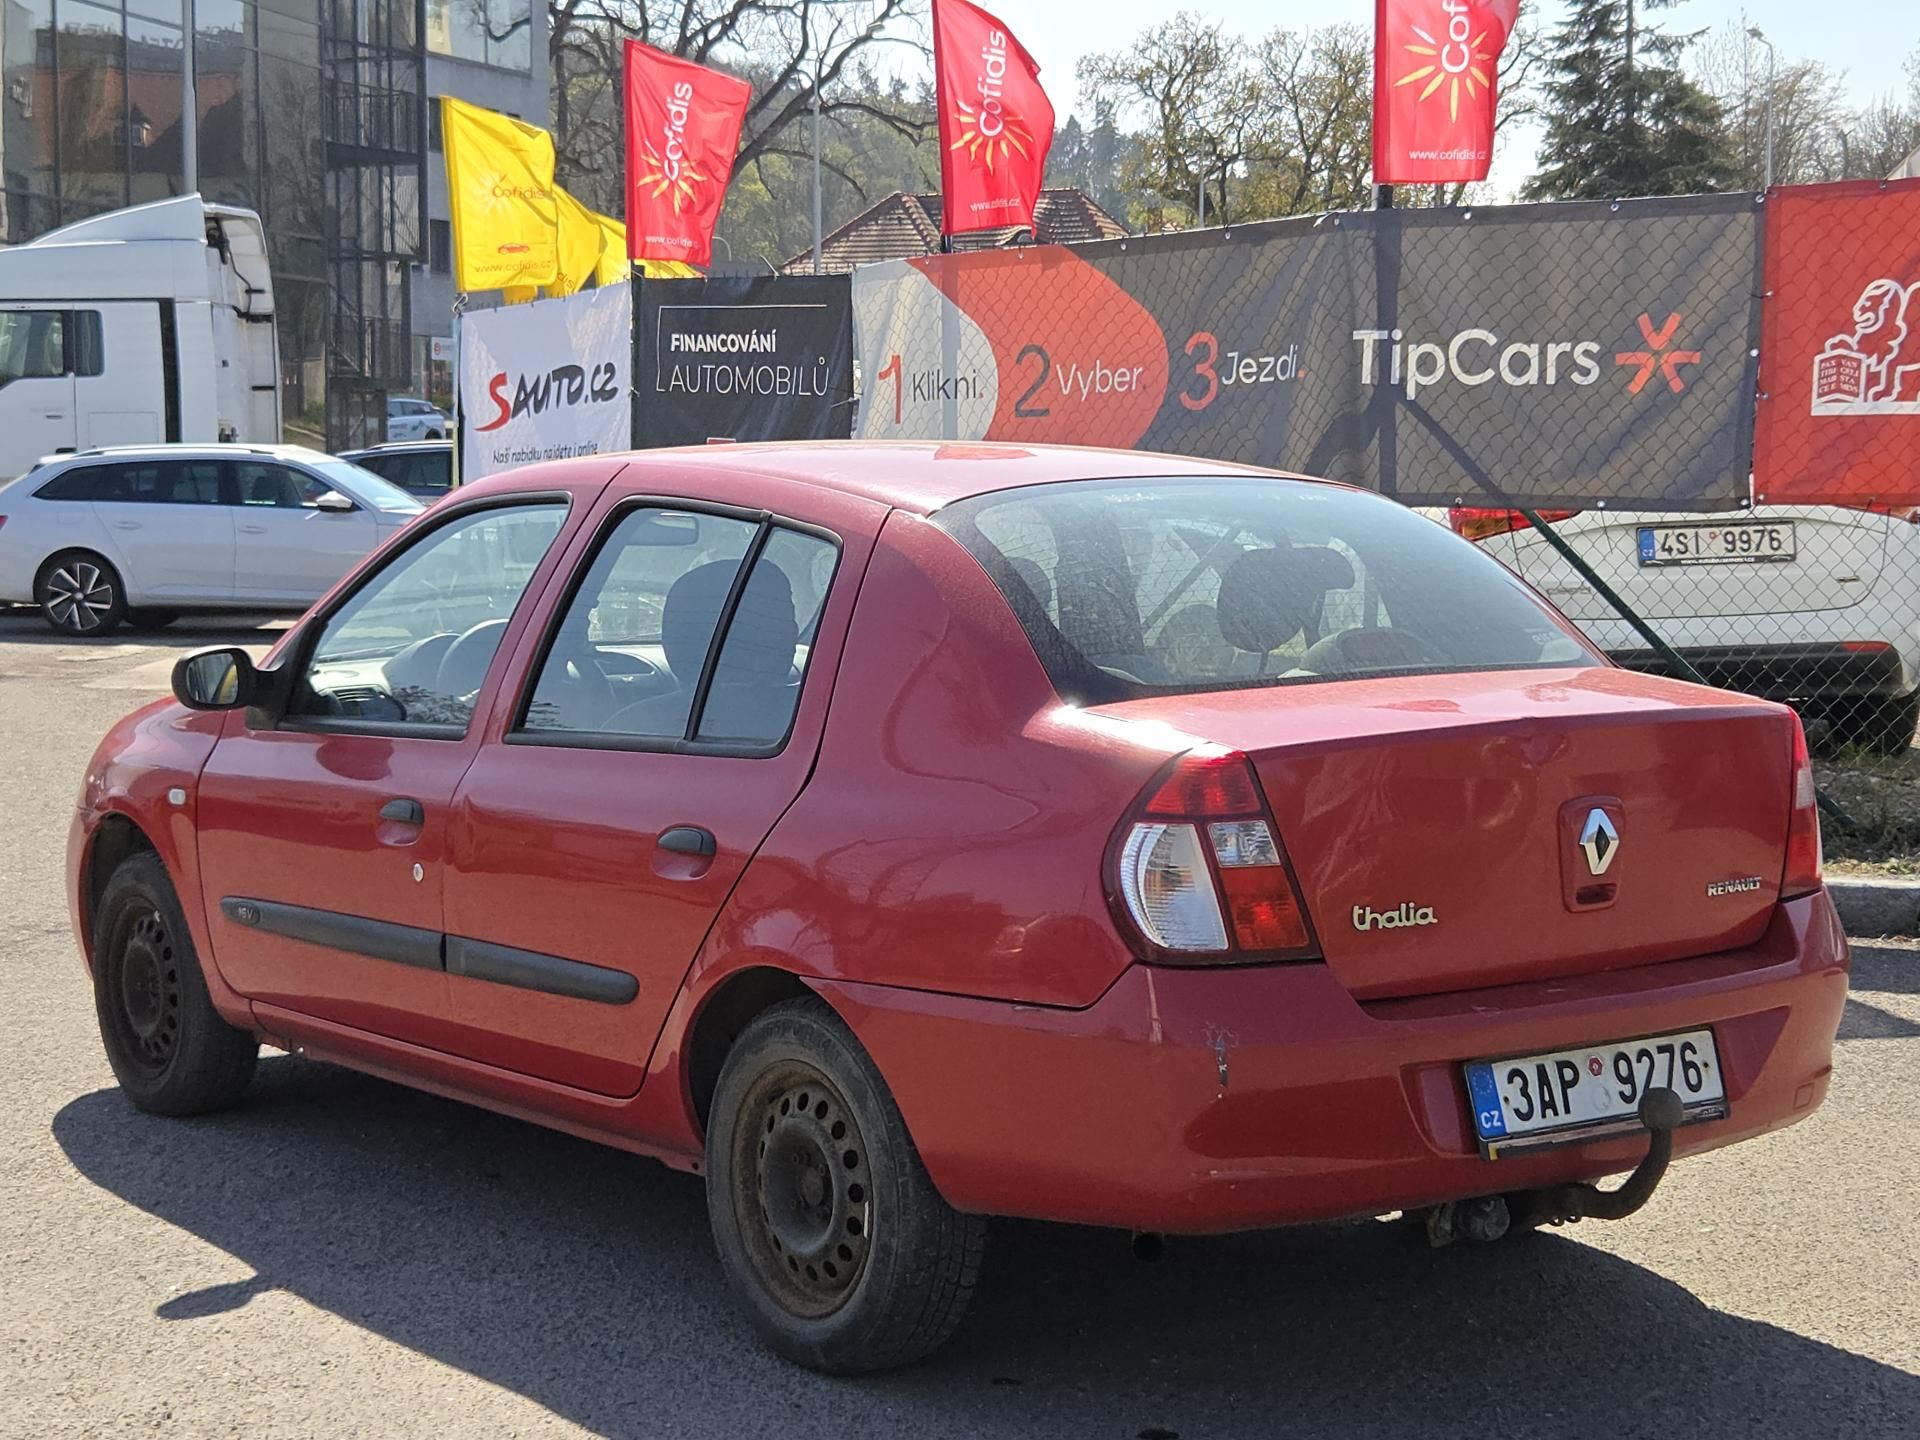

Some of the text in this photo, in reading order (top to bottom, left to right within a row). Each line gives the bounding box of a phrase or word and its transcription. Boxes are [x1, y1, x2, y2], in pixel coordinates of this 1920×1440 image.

[977, 30, 1007, 137] Cofidis
[663, 81, 694, 182] Cofidis
[1408, 149, 1487, 161] www.cofidis.cz
[492, 184, 545, 200] Cofidis
[670, 329, 777, 353] FINANCOVÁNÍ
[669, 357, 830, 397] AUTOMOBILŮ
[1014, 344, 1051, 419] 2
[1179, 331, 1307, 412] 3 Jezdi.
[1352, 328, 1601, 401] TipCars
[878, 354, 902, 425] 1
[1660, 528, 1782, 557] 4SI 9976
[1707, 876, 1762, 897] RENAULT
[1352, 903, 1439, 931] thalia
[1507, 1041, 1703, 1123] 3AP 9276
[1480, 1110, 1502, 1130] CZ
